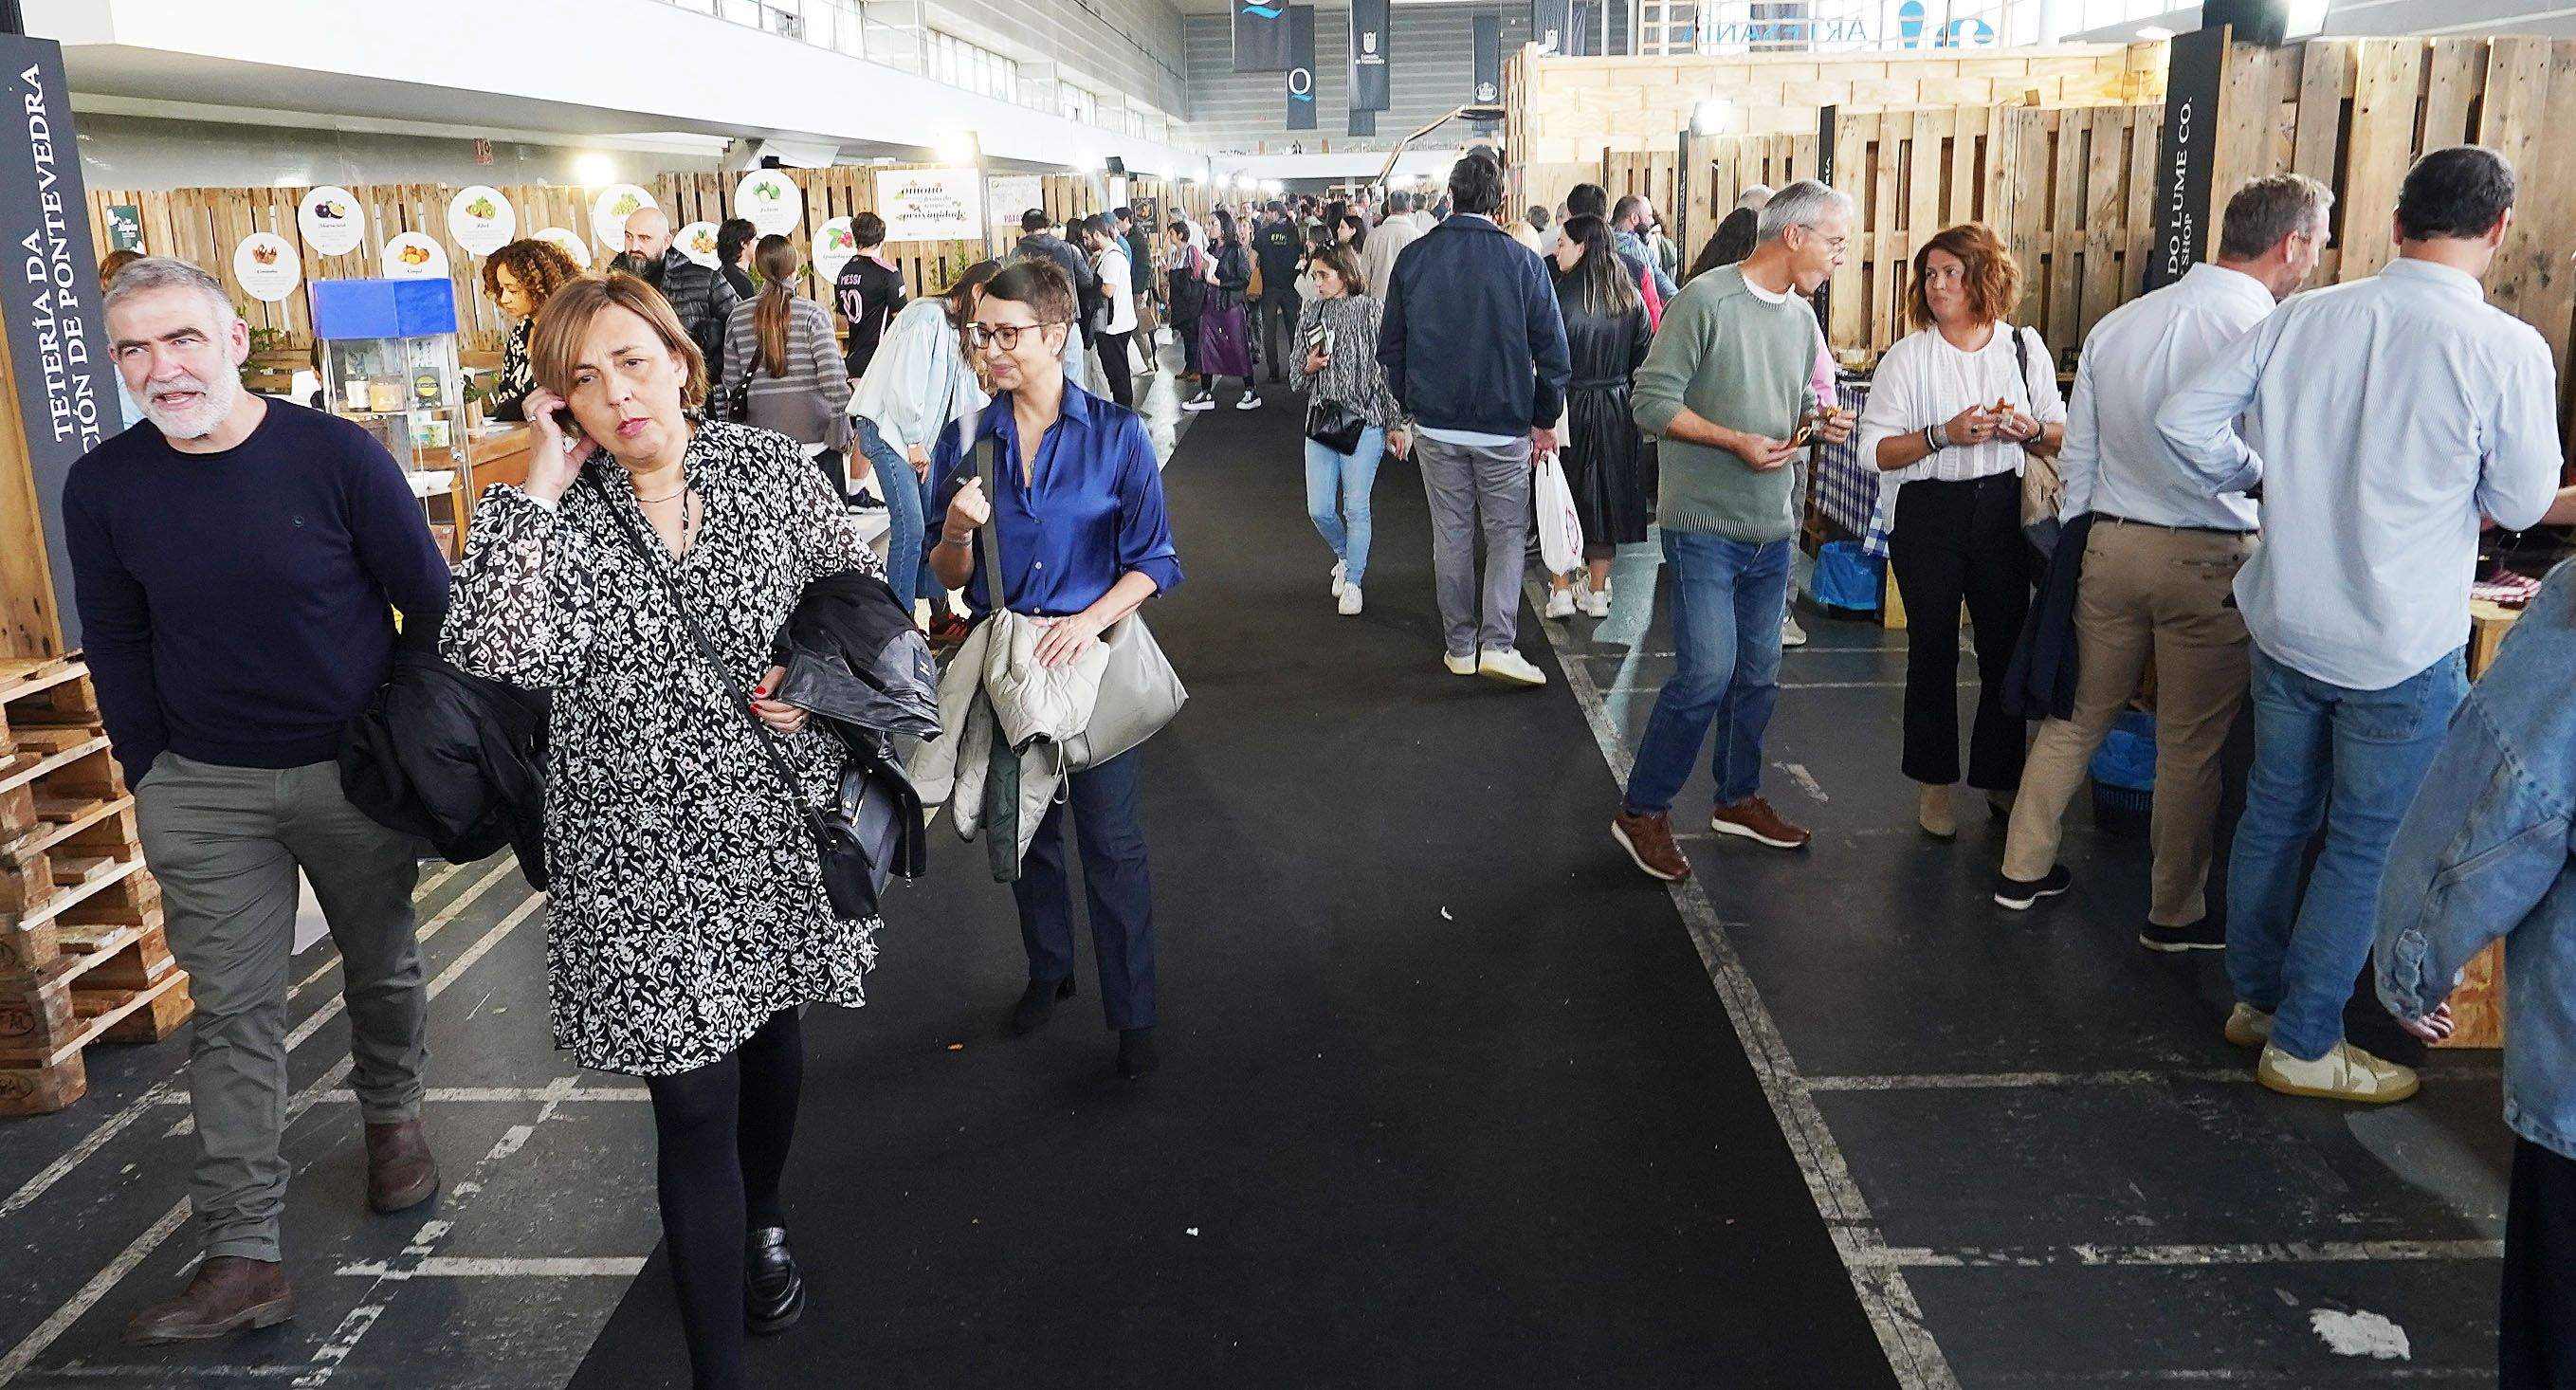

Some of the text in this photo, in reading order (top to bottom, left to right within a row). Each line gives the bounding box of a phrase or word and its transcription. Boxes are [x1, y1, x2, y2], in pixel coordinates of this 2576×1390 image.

[20, 63, 79, 309] PONTEVEDRA
[2167, 97, 2192, 275] DO LUME CO.
[2182, 212, 2193, 265] SHOP
[840, 273, 862, 285] MESSI
[839, 288, 863, 324] 10
[21, 229, 74, 442] TETERÍA DA
[63, 316, 89, 366] DE
